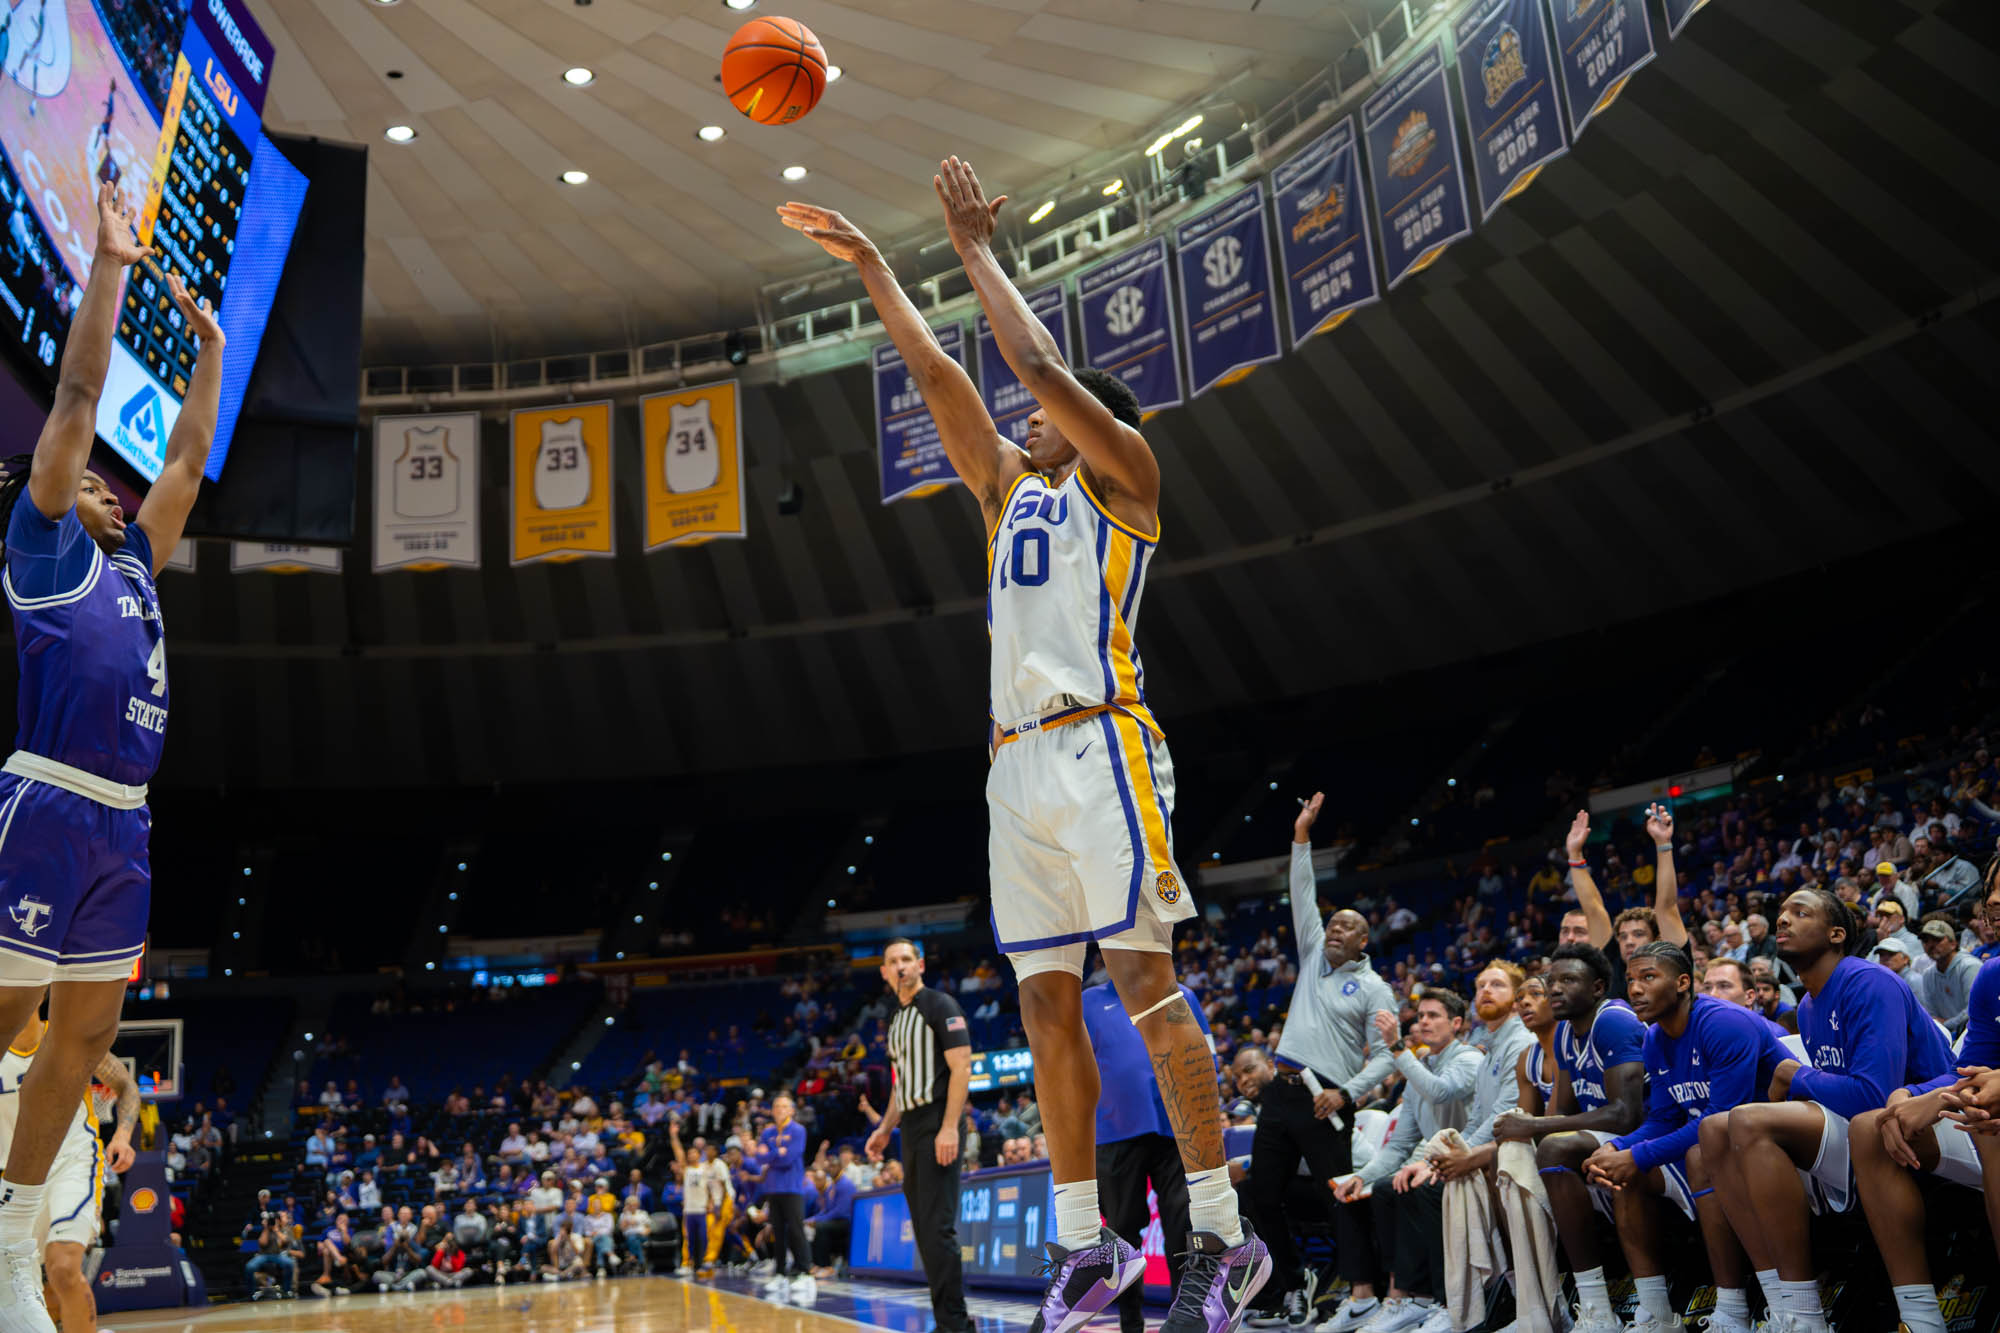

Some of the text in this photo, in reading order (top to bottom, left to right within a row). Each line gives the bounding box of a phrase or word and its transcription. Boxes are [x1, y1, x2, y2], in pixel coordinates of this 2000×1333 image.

[208, 0, 263, 85] OWERADE
[1576, 4, 1627, 68] FINAL FOUR
[1585, 30, 1623, 88] 2007
[204, 57, 238, 118] LSU
[1487, 100, 1541, 156] FINAL FOUR
[1495, 124, 1538, 176] 2006
[1393, 183, 1446, 232] FINAL FOUR
[1401, 204, 1443, 251] 2005
[1202, 235, 1243, 289] SEC
[1301, 250, 1355, 293] FINAL FOUR
[1103, 285, 1146, 336] SEC
[1309, 269, 1352, 313] 2004
[547, 446, 578, 471] 33
[676, 428, 706, 455] 34
[409, 455, 443, 481] 33
[1000, 527, 1050, 591] 10
[146, 637, 167, 698] 4
[125, 696, 168, 735] STATE
[1017, 719, 1038, 734] LSU
